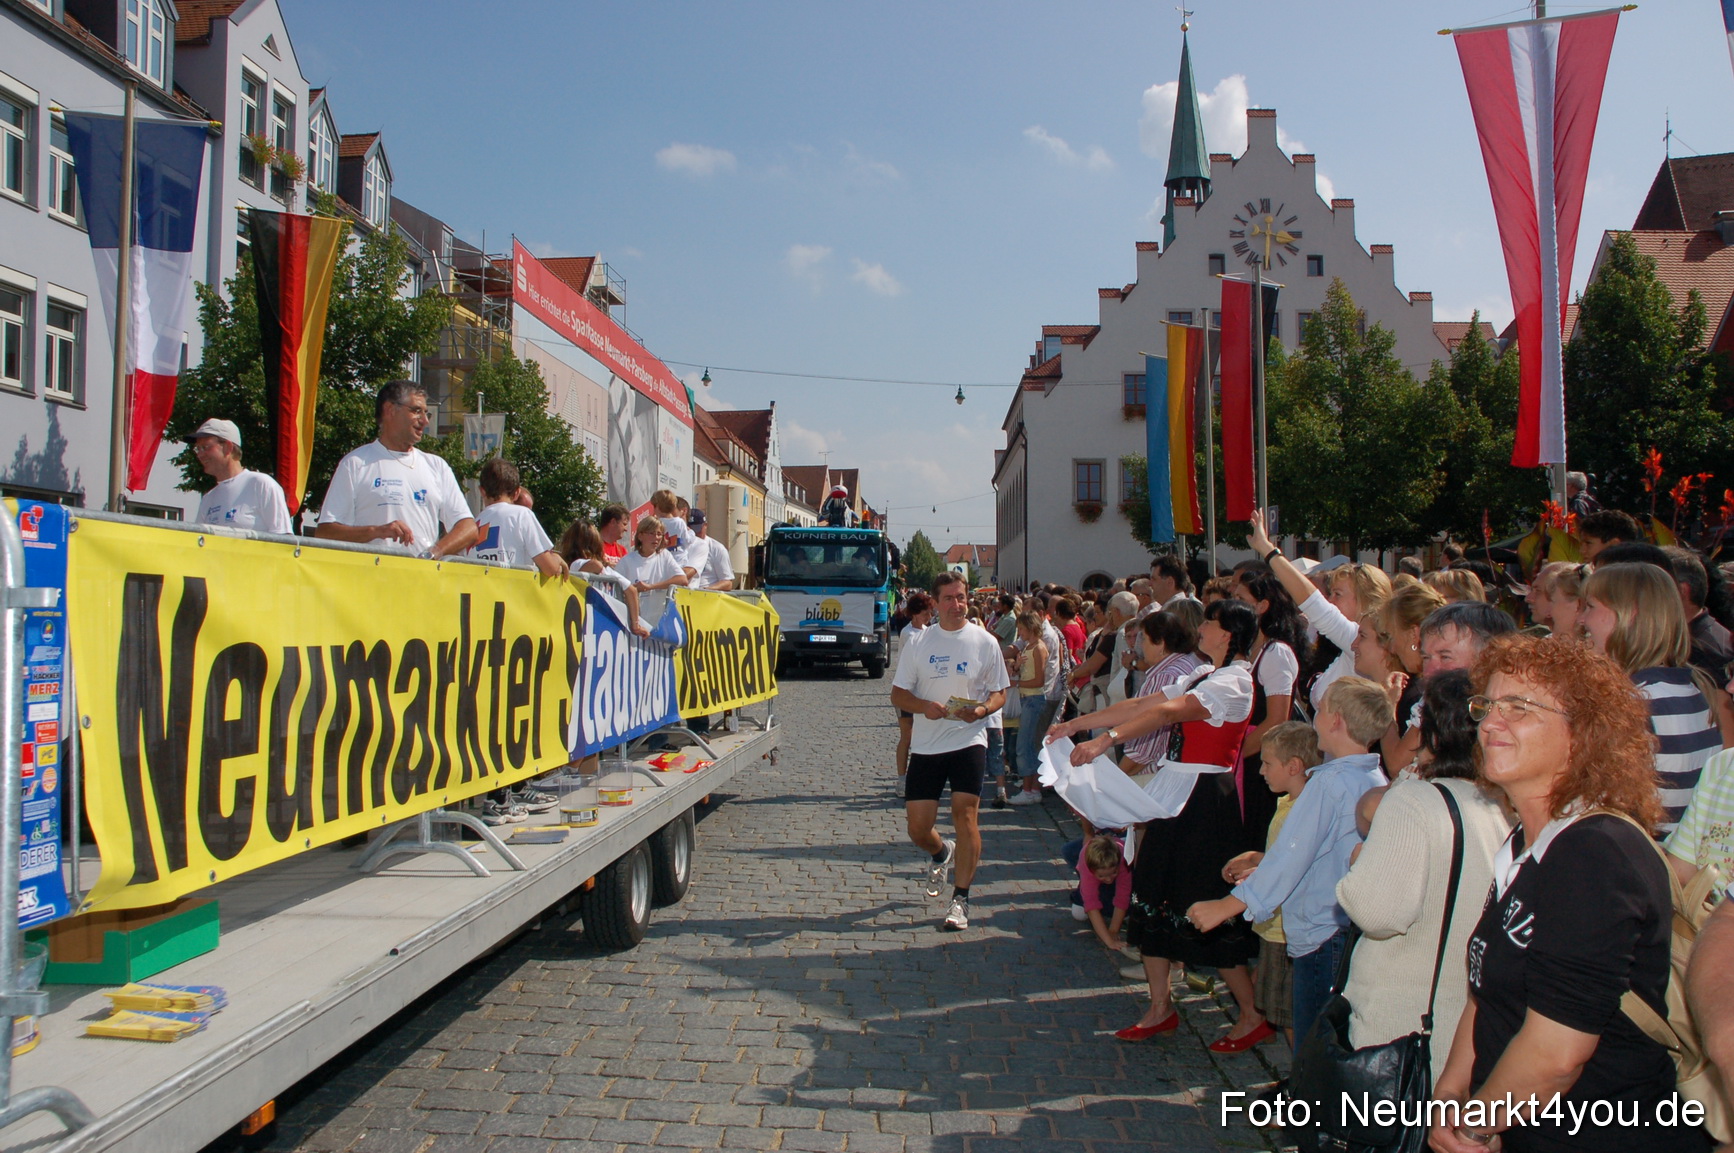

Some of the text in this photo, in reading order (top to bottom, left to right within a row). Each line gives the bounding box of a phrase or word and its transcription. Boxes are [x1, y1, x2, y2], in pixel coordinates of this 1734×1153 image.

[528, 282, 540, 304] Hier
[540, 295, 562, 322] errichtet
[562, 309, 571, 327] die
[571, 310, 604, 351] Sparkasse
[805, 602, 840, 621] blübb
[29, 682, 60, 696] MERZ
[116, 572, 554, 886] Neumarkter
